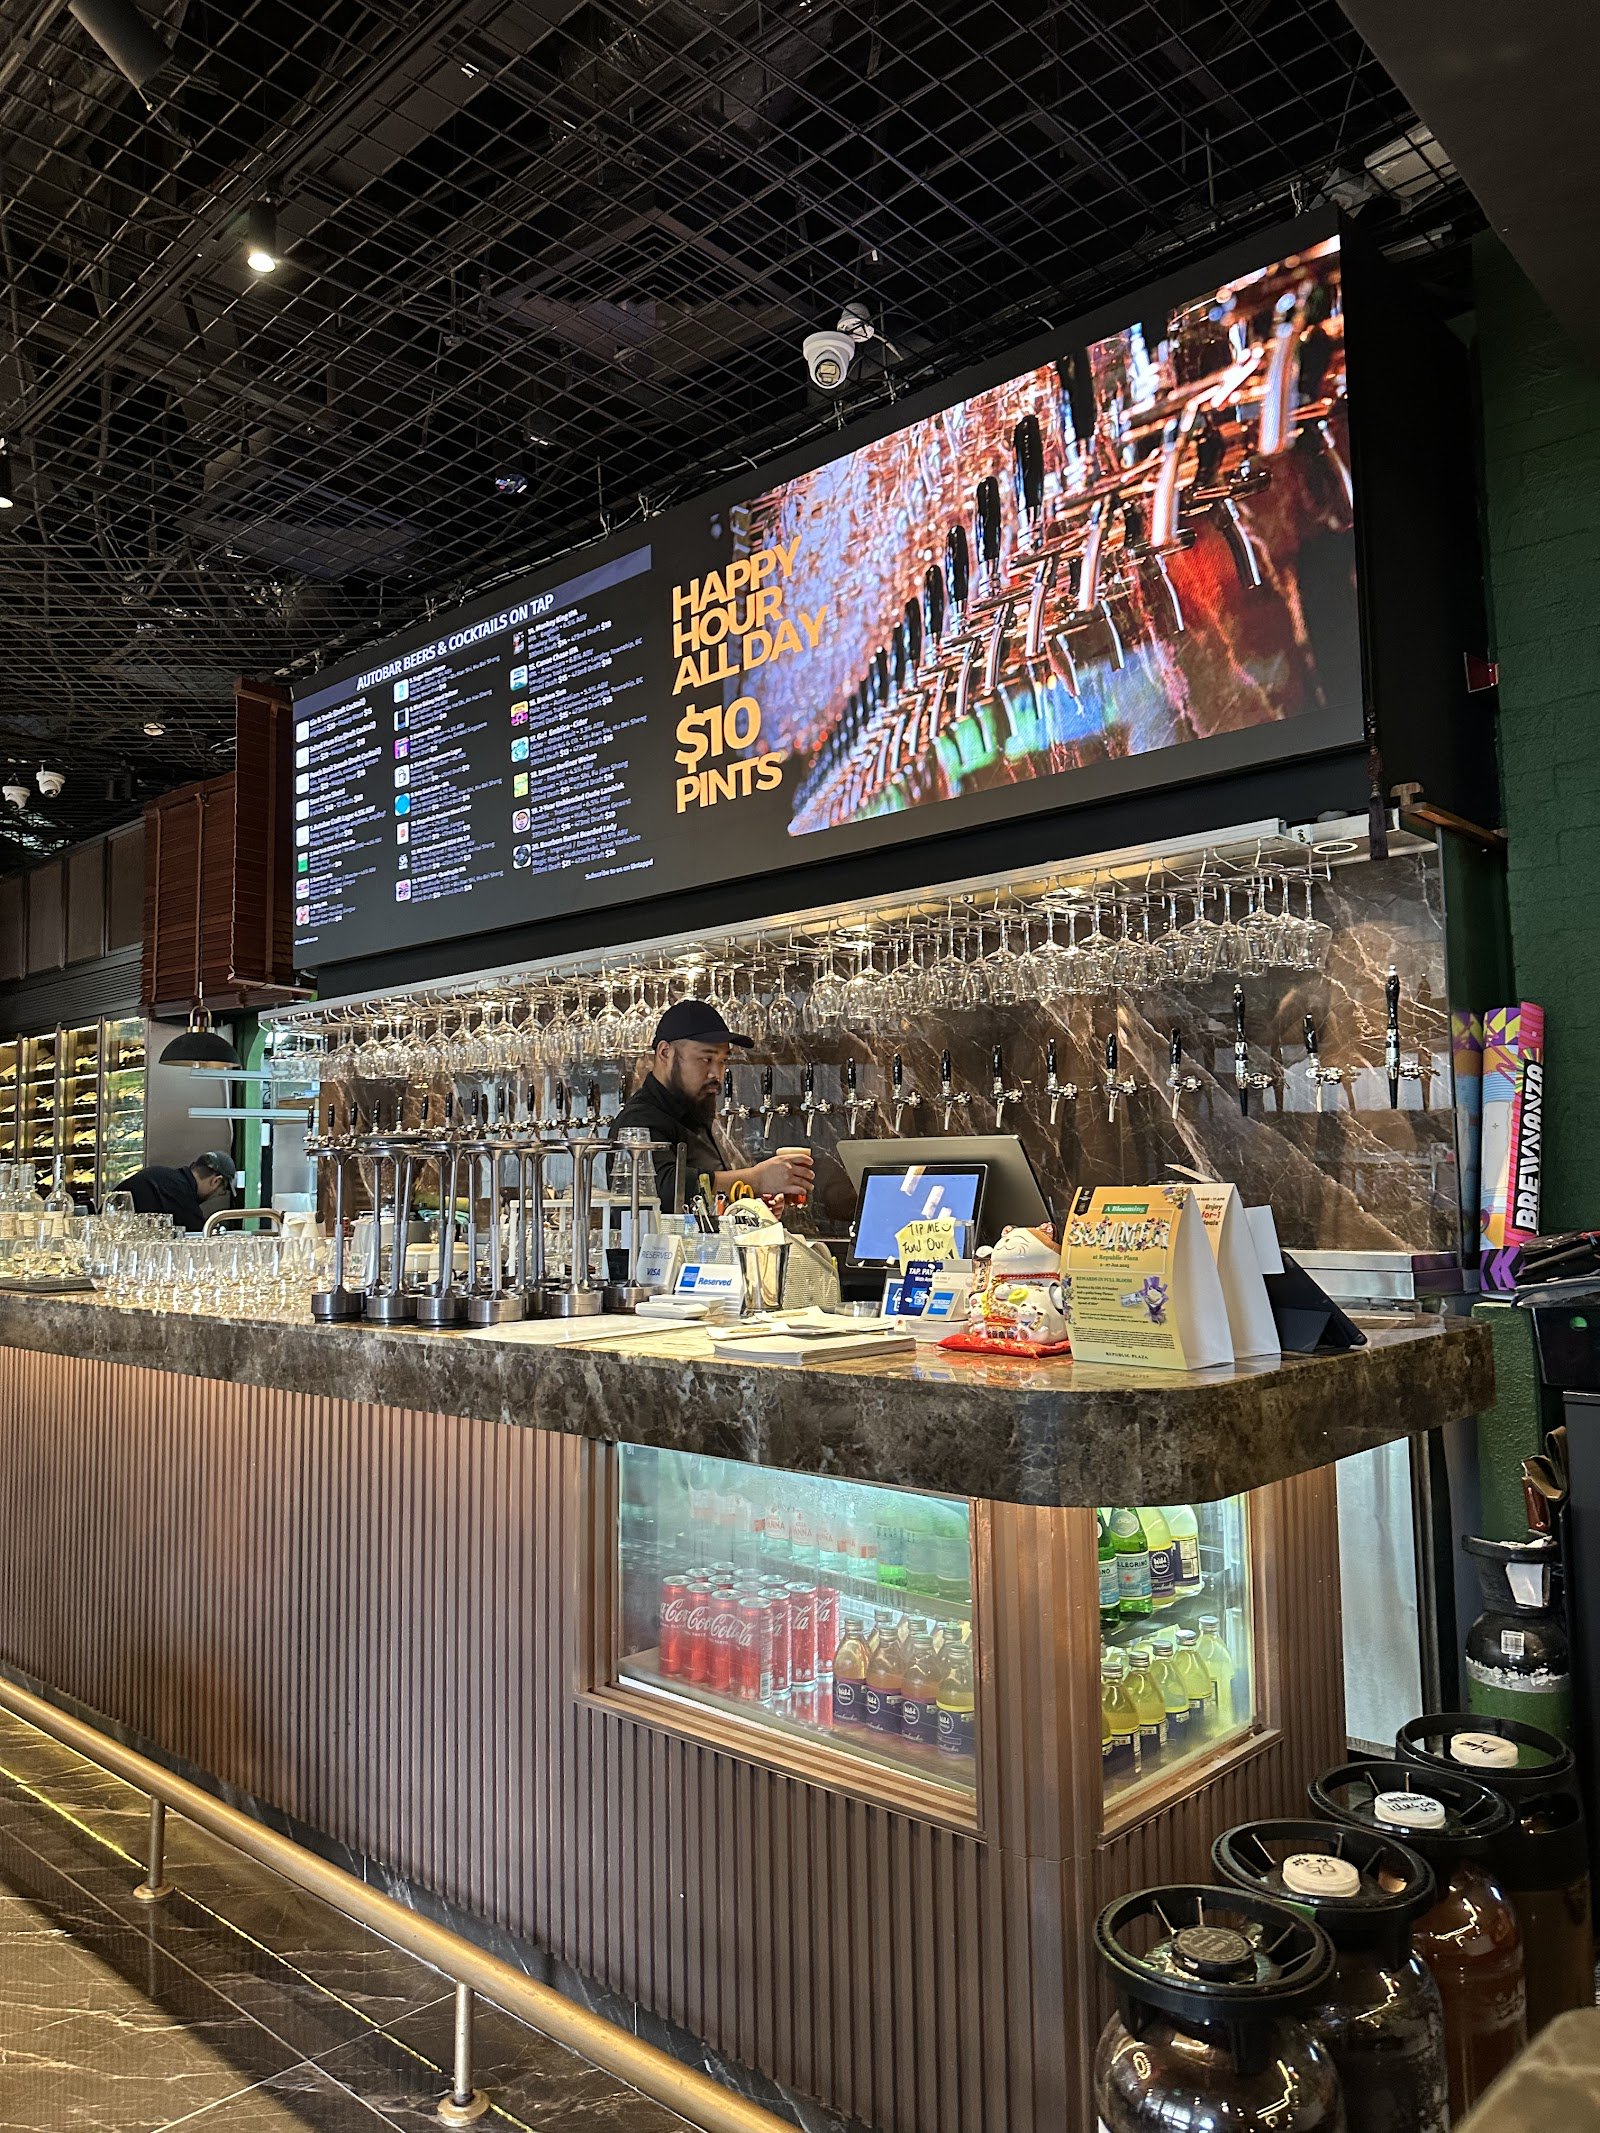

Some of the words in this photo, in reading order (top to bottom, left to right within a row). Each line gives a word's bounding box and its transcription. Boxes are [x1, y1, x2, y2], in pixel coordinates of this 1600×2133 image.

[672, 536, 801, 622] HAPPY
[356, 660, 402, 691] AUTOBAR
[403, 645, 436, 671] BEERS
[438, 641, 447, 655] &
[449, 614, 507, 650] COCKTAILS
[509, 605, 528, 625] ON
[530, 594, 553, 616] TAP
[672, 642, 740, 695] ALL
[743, 605, 828, 671] DAY
[673, 585, 783, 659] HOUR
[674, 696, 761, 774] $10
[676, 752, 783, 814] PINTS
[1516, 1064, 1542, 1230] BREWNANZA
[641, 1251, 672, 1259] RESERVED
[902, 1240, 922, 1254] Fund
[909, 1224, 923, 1235] TIP
[927, 1222, 940, 1232] ME
[1068, 1221, 1170, 1251] SUMMER
[647, 1268, 661, 1276] VISA
[698, 1277, 732, 1286] Reserved
